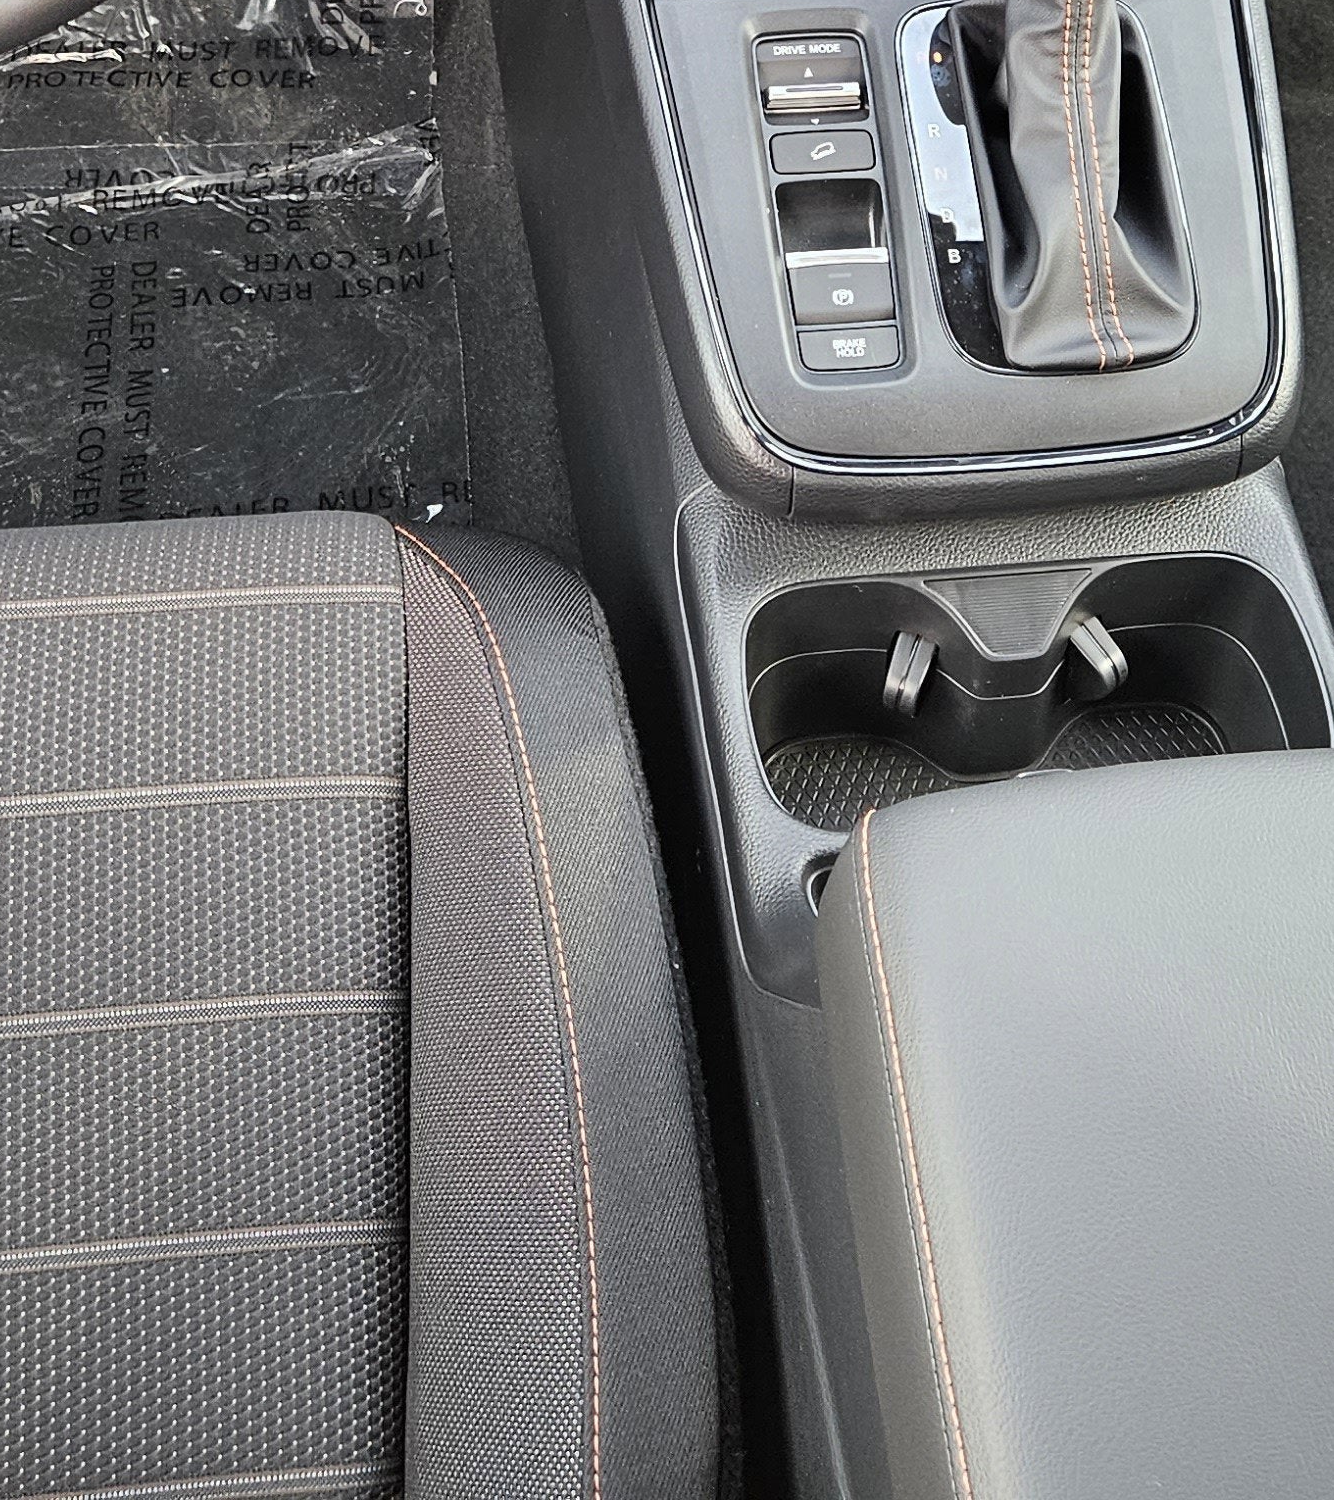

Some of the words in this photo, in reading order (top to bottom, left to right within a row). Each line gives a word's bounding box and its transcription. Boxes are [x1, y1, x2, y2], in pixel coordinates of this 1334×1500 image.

[772, 44, 807, 56] DRIVE
[809, 43, 842, 55] MODE
[6, 68, 189, 90] PROTECTIVE
[209, 67, 315, 90] COVER
[927, 123, 941, 138] R
[934, 166, 948, 180] N
[940, 208, 954, 223] D
[44, 220, 160, 245] COVER
[243, 250, 357, 274] COVER
[947, 248, 961, 264] B
[171, 281, 313, 309] REMOVE
[334, 271, 425, 300] MUST
[127, 260, 158, 352] DEALER
[80, 265, 115, 416] PROTECTIVE
[832, 337, 866, 349] BRAKE
[835, 348, 865, 358] HOLD
[123, 368, 154, 437] MUST
[72, 425, 107, 520] COVER
